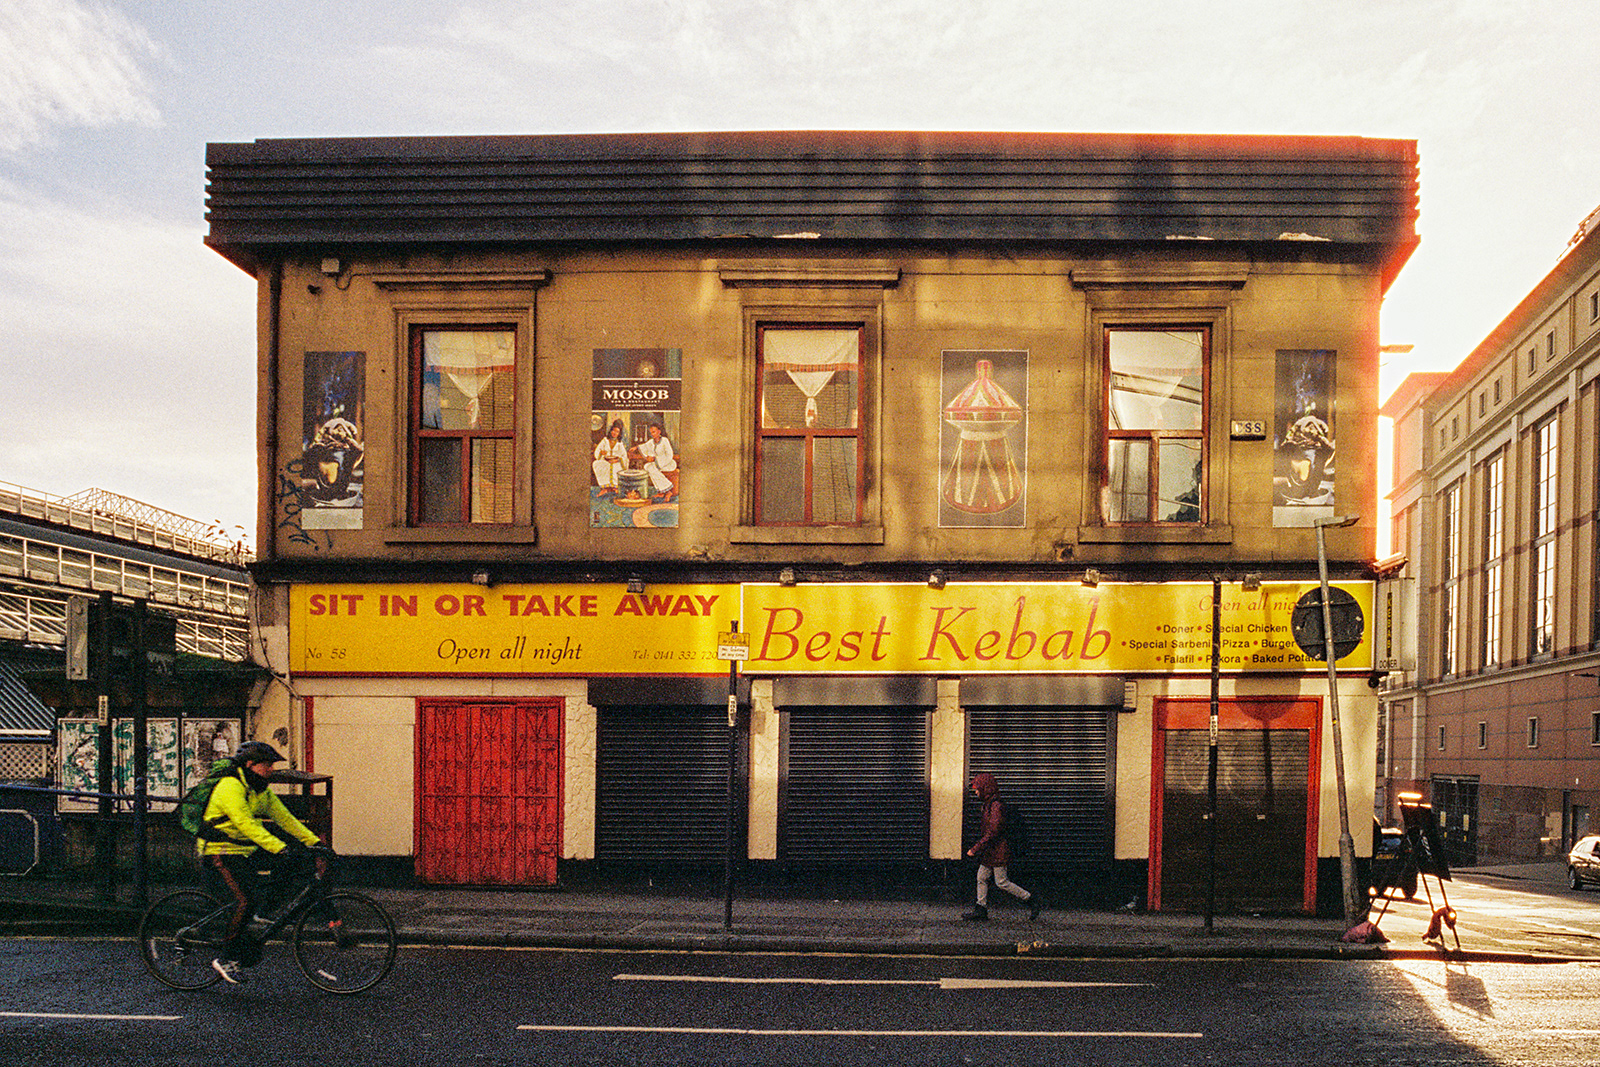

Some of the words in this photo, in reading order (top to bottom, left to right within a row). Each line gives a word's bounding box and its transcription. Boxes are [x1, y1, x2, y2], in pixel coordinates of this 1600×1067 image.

[603, 389, 669, 400] MOSOB
[309, 594, 364, 616] SIT
[379, 594, 418, 617] IN
[434, 594, 487, 616] OR
[502, 595, 598, 616] TAKE
[613, 595, 720, 616] AWAY
[1199, 594, 1240, 616] Oen
[1248, 592, 1269, 611] all
[1273, 592, 1303, 615] nig
[750, 607, 891, 662] Best
[918, 595, 1112, 662] Kebab
[1163, 624, 1194, 633] Doner
[1205, 624, 1243, 633] Secial
[1247, 624, 1288, 633] Chicken
[1129, 639, 1168, 650] Special
[1171, 639, 1211, 649] Sarbeni
[1222, 639, 1250, 648] Pizza
[306, 648, 322, 659] No
[330, 648, 347, 659] 58
[437, 638, 491, 665] Open
[499, 636, 527, 659] all
[533, 636, 583, 665] night
[633, 649, 650, 660] Tel:
[653, 650, 674, 660] 0141
[678, 650, 697, 660] 332
[701, 650, 718, 660] 720
[1164, 654, 1195, 664] Falafil
[1205, 654, 1241, 664] Pkora
[1252, 654, 1284, 663] Baked
